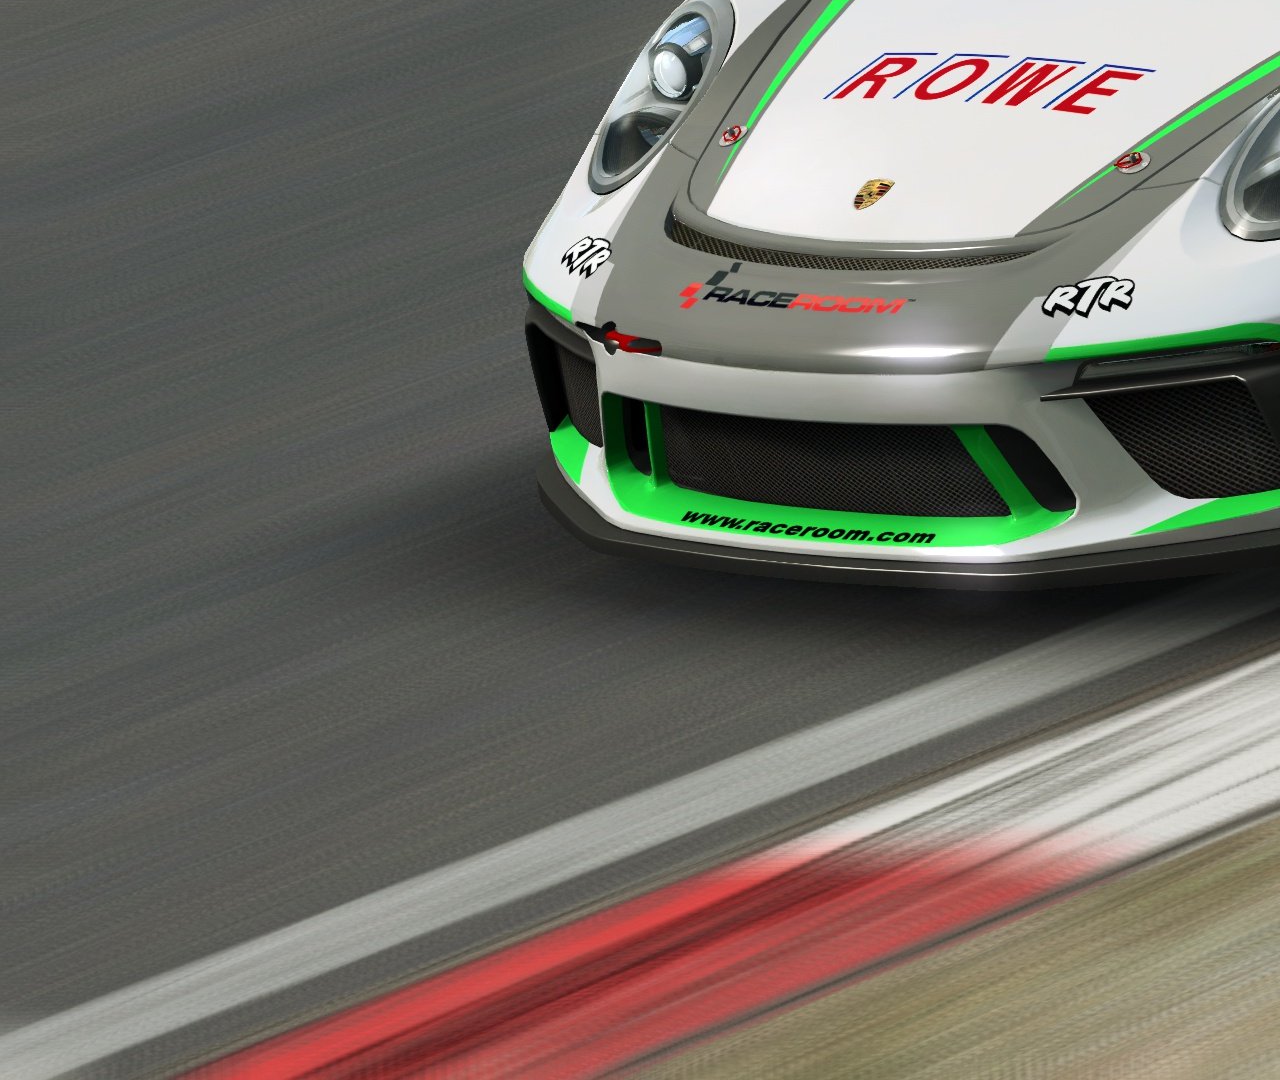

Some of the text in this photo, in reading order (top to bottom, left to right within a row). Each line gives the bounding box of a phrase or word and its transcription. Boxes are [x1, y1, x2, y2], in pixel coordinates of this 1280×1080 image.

[828, 54, 1152, 115] ROWE
[561, 235, 612, 279] RTR
[702, 286, 908, 314] RACEROOM
[1041, 275, 1136, 319] RTR
[680, 510, 936, 544] www.raceroom.com
